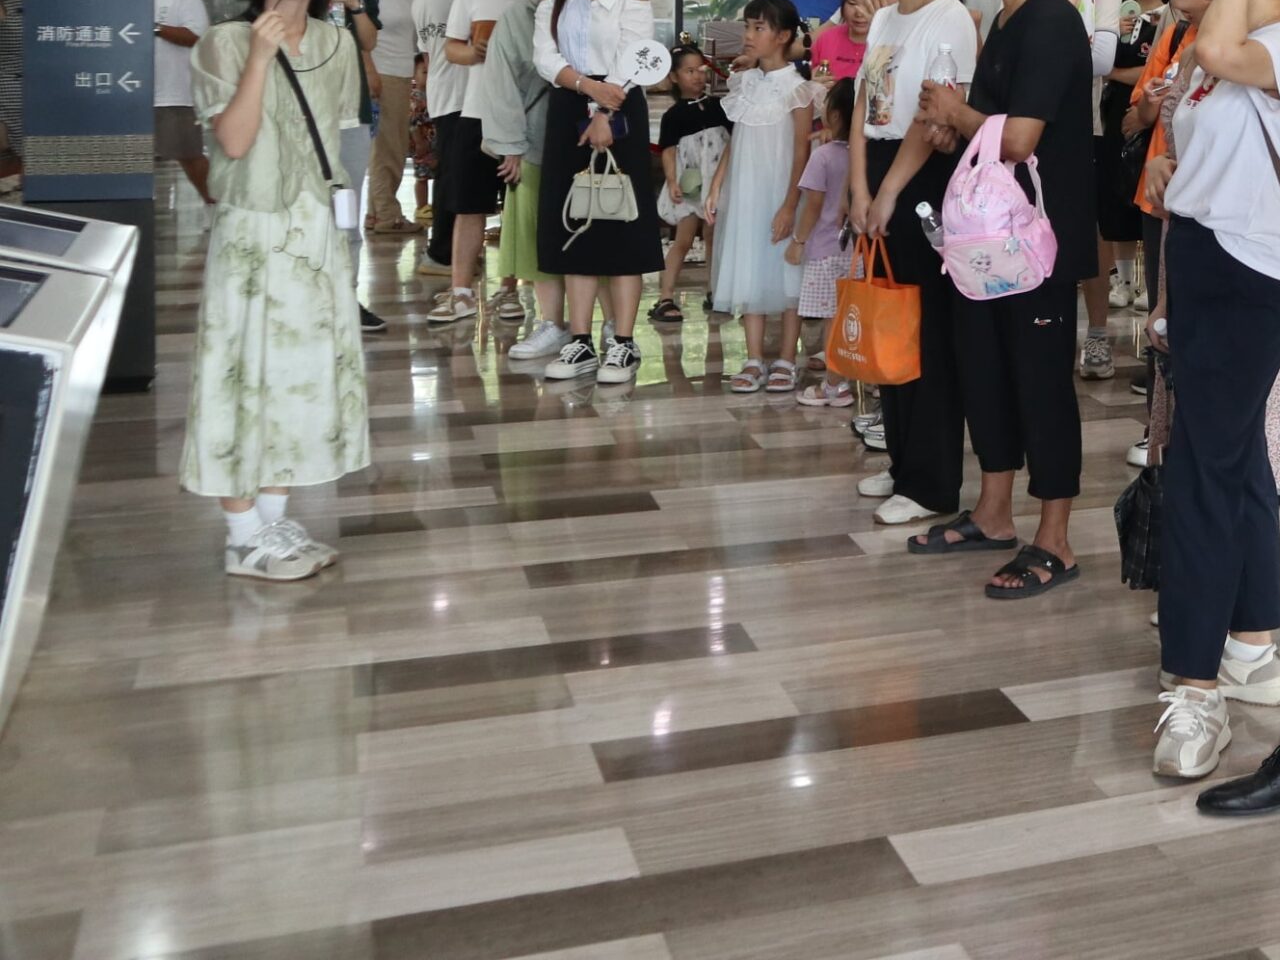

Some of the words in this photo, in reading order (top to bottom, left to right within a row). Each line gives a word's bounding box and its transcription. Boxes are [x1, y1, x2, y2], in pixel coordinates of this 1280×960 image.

[37, 25, 113, 42] 消防通道
[75, 72, 112, 88] 出口
